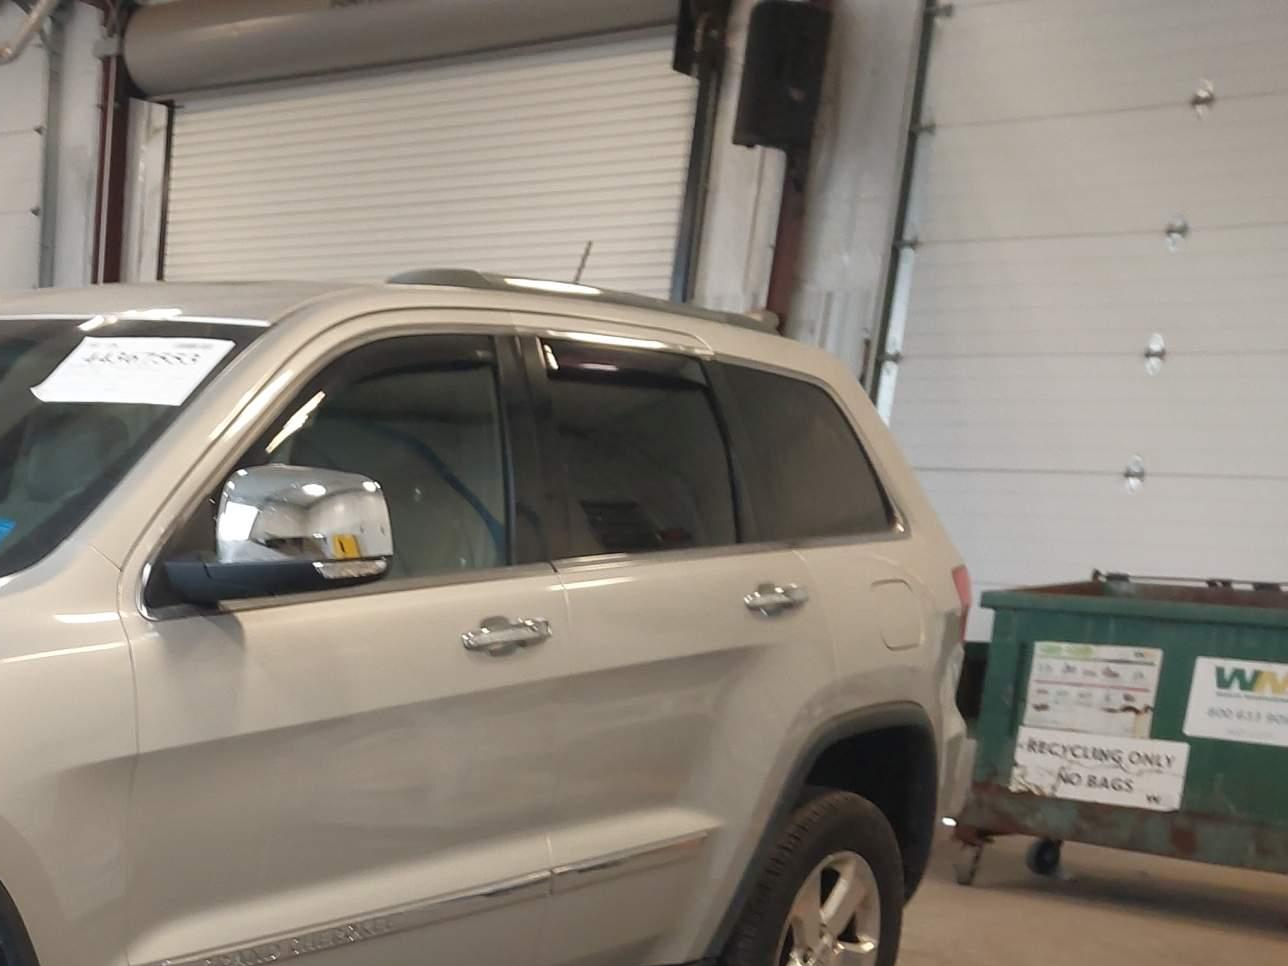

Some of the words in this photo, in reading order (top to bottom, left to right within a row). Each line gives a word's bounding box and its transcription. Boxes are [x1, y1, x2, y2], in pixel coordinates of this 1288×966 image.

[1026, 738, 1123, 764] RECYCLING
[1128, 750, 1177, 769] ONLY
[1057, 769, 1083, 787] NO
[1087, 775, 1135, 793] BAGS
